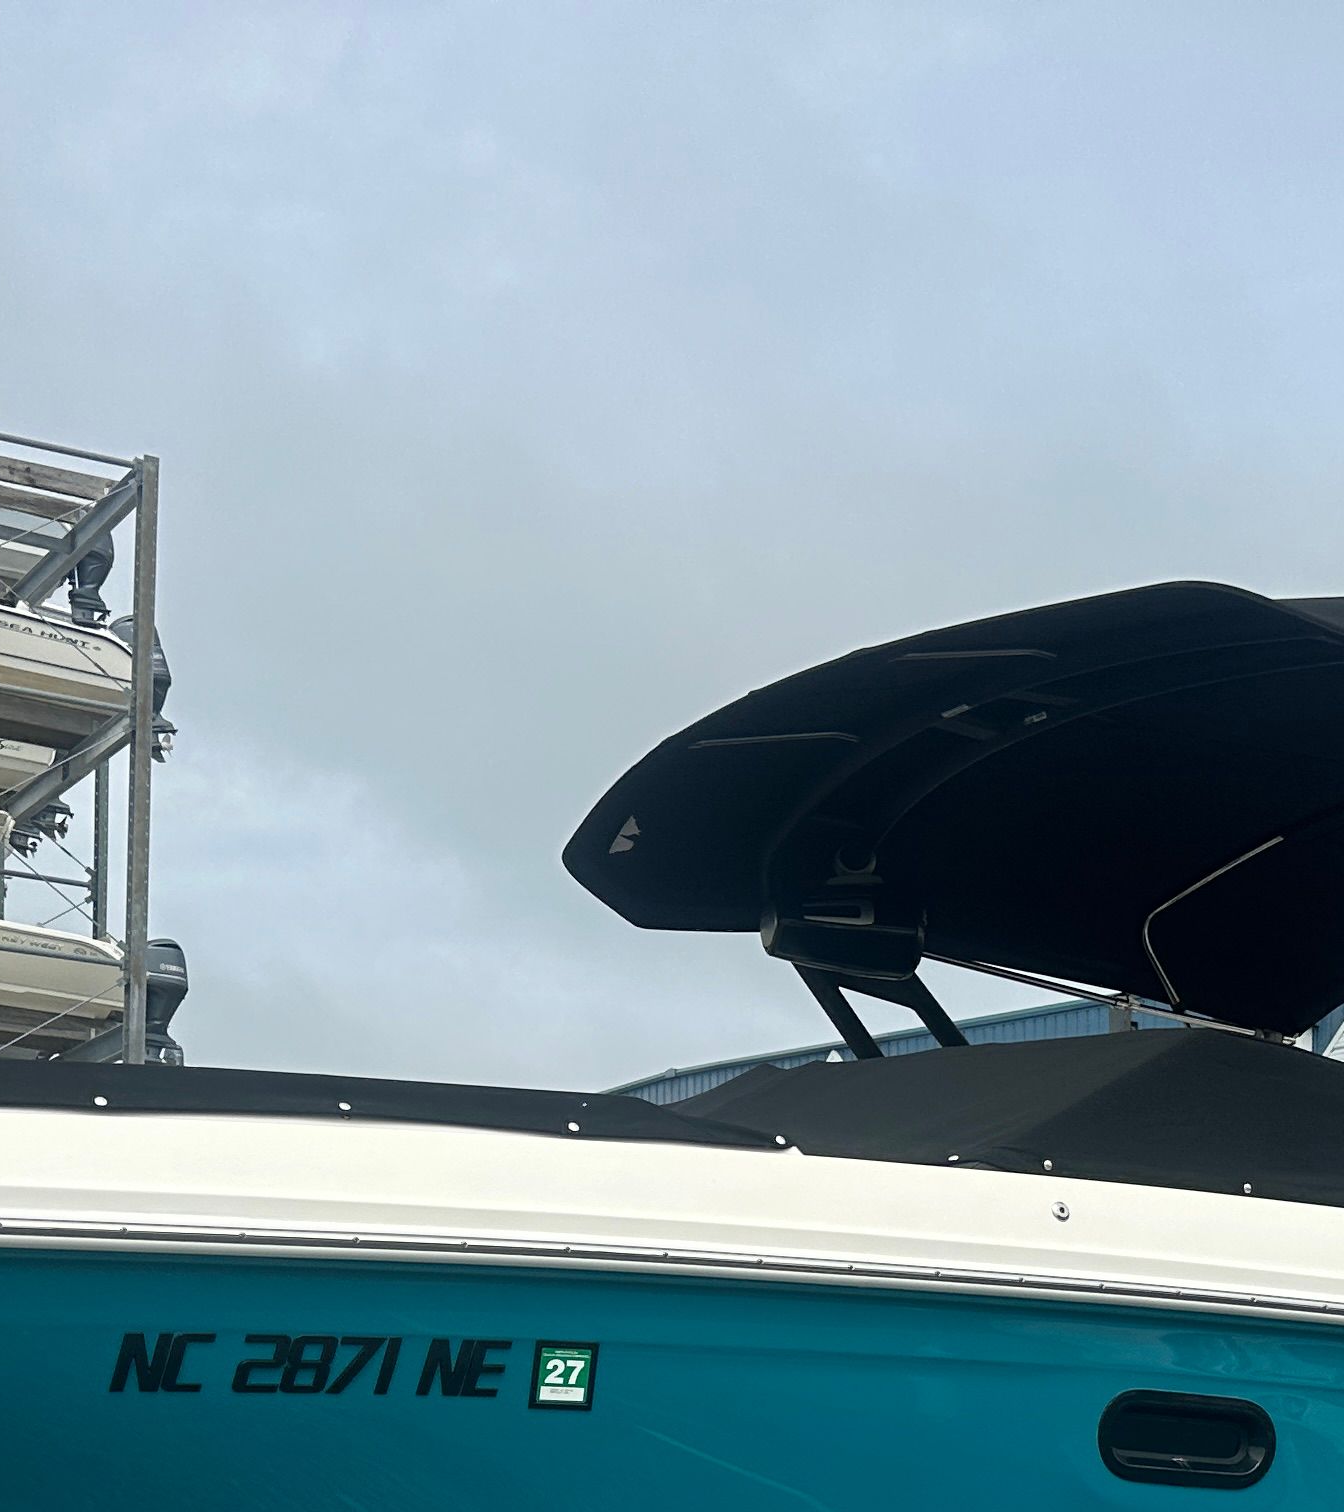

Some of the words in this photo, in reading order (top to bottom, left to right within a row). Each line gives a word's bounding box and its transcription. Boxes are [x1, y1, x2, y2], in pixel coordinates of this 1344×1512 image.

[109, 1332, 216, 1394] NC
[232, 1334, 403, 1395] 2871
[416, 1338, 513, 1398] NE
[544, 1359, 585, 1385] 27
